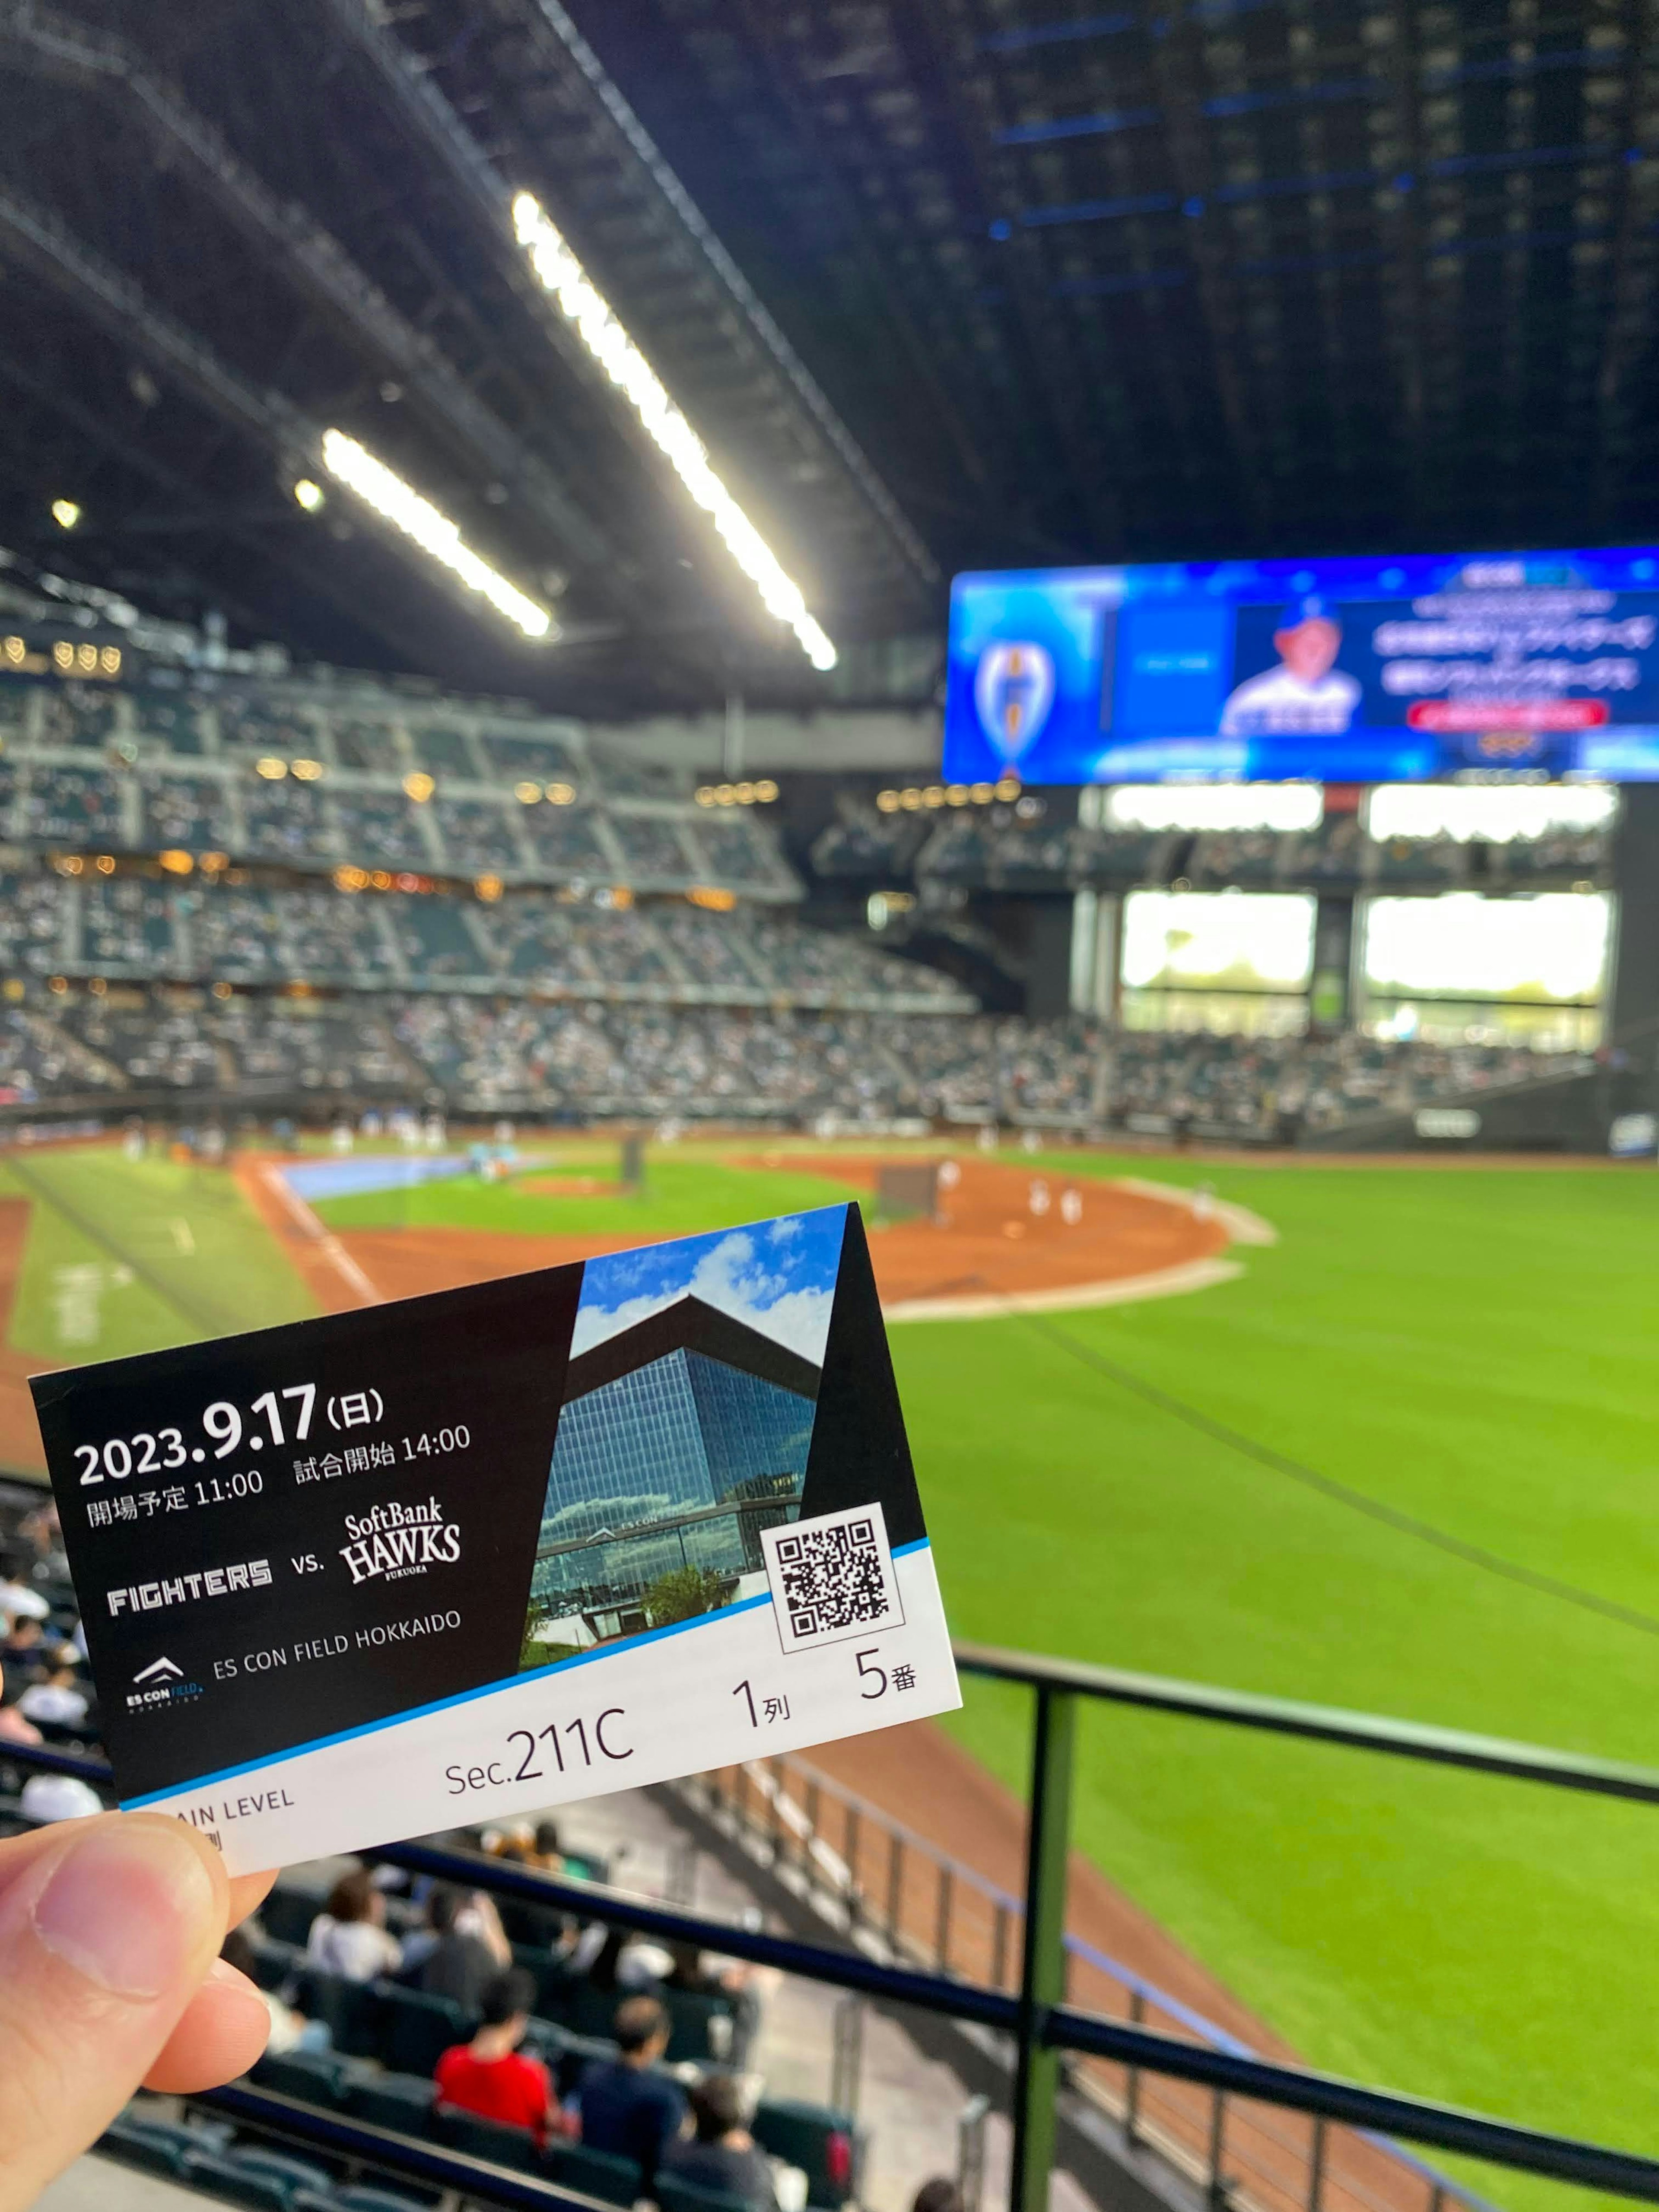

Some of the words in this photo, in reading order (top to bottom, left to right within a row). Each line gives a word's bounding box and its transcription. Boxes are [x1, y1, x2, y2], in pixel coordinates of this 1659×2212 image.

[74, 1383, 316, 1485] 2023.9.17
[87, 1486, 189, 1528] 開場予定
[195, 1470, 263, 1506] 11:00
[293, 1441, 395, 1485] 試合開始
[402, 1425, 470, 1461] 14:00
[345, 1496, 443, 1541] SoftBank
[339, 1524, 461, 1585] HAWKS
[384, 1564, 428, 1582] FUKUOKA
[107, 1558, 273, 1617] FIGHTERS
[291, 1554, 324, 1575] vs.
[213, 1659, 238, 1680] ES
[244, 1648, 287, 1672] CON
[294, 1635, 348, 1662] FIELD
[355, 1610, 461, 1648] HOKKAIDO
[143, 1688, 171, 1703] CON
[855, 1648, 916, 1699] 5番
[732, 1680, 790, 1727] 1列
[224, 1789, 295, 1819] LEVEL
